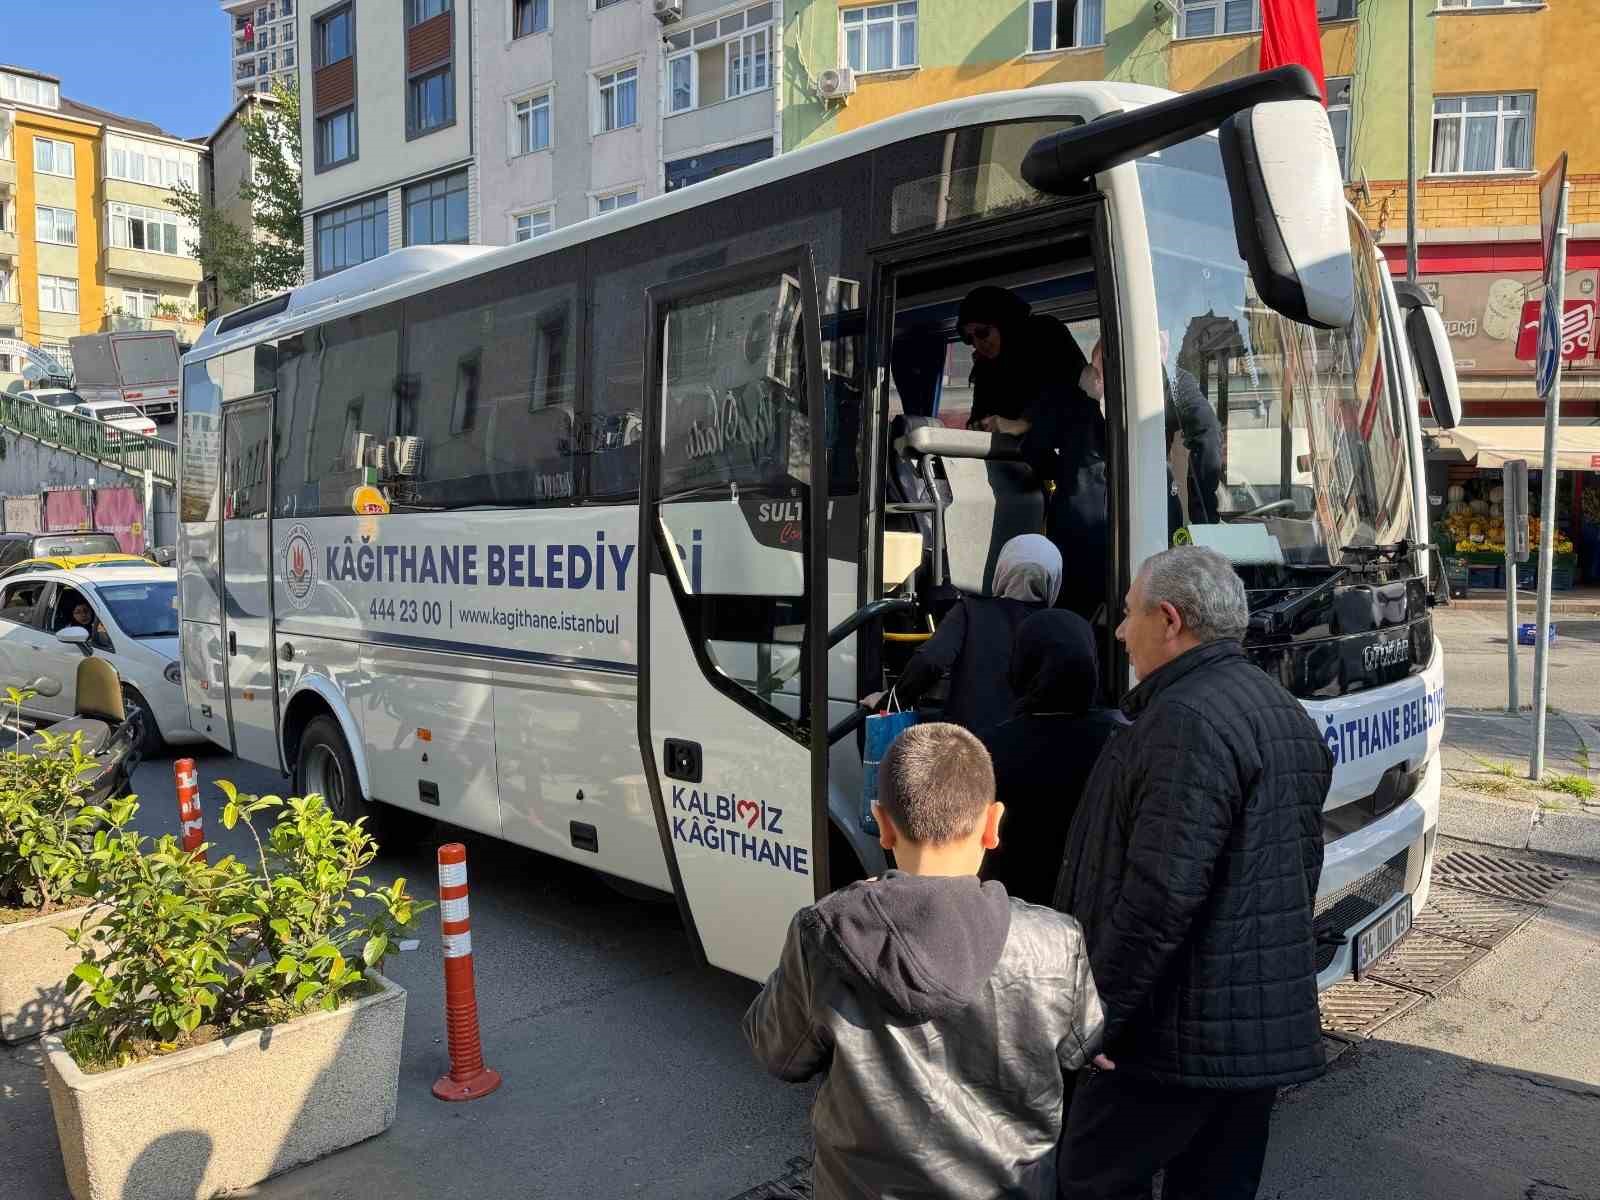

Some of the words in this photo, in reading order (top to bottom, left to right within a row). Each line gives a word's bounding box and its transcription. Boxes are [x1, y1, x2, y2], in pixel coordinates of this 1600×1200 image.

[326, 535, 478, 586] KÂĞITHANE
[369, 598, 395, 621] 444
[399, 600, 418, 623] 23
[422, 601, 442, 626] 00
[458, 606, 619, 635] www.kagithane.istanbul
[673, 816, 809, 875] KÂĞITHANE
